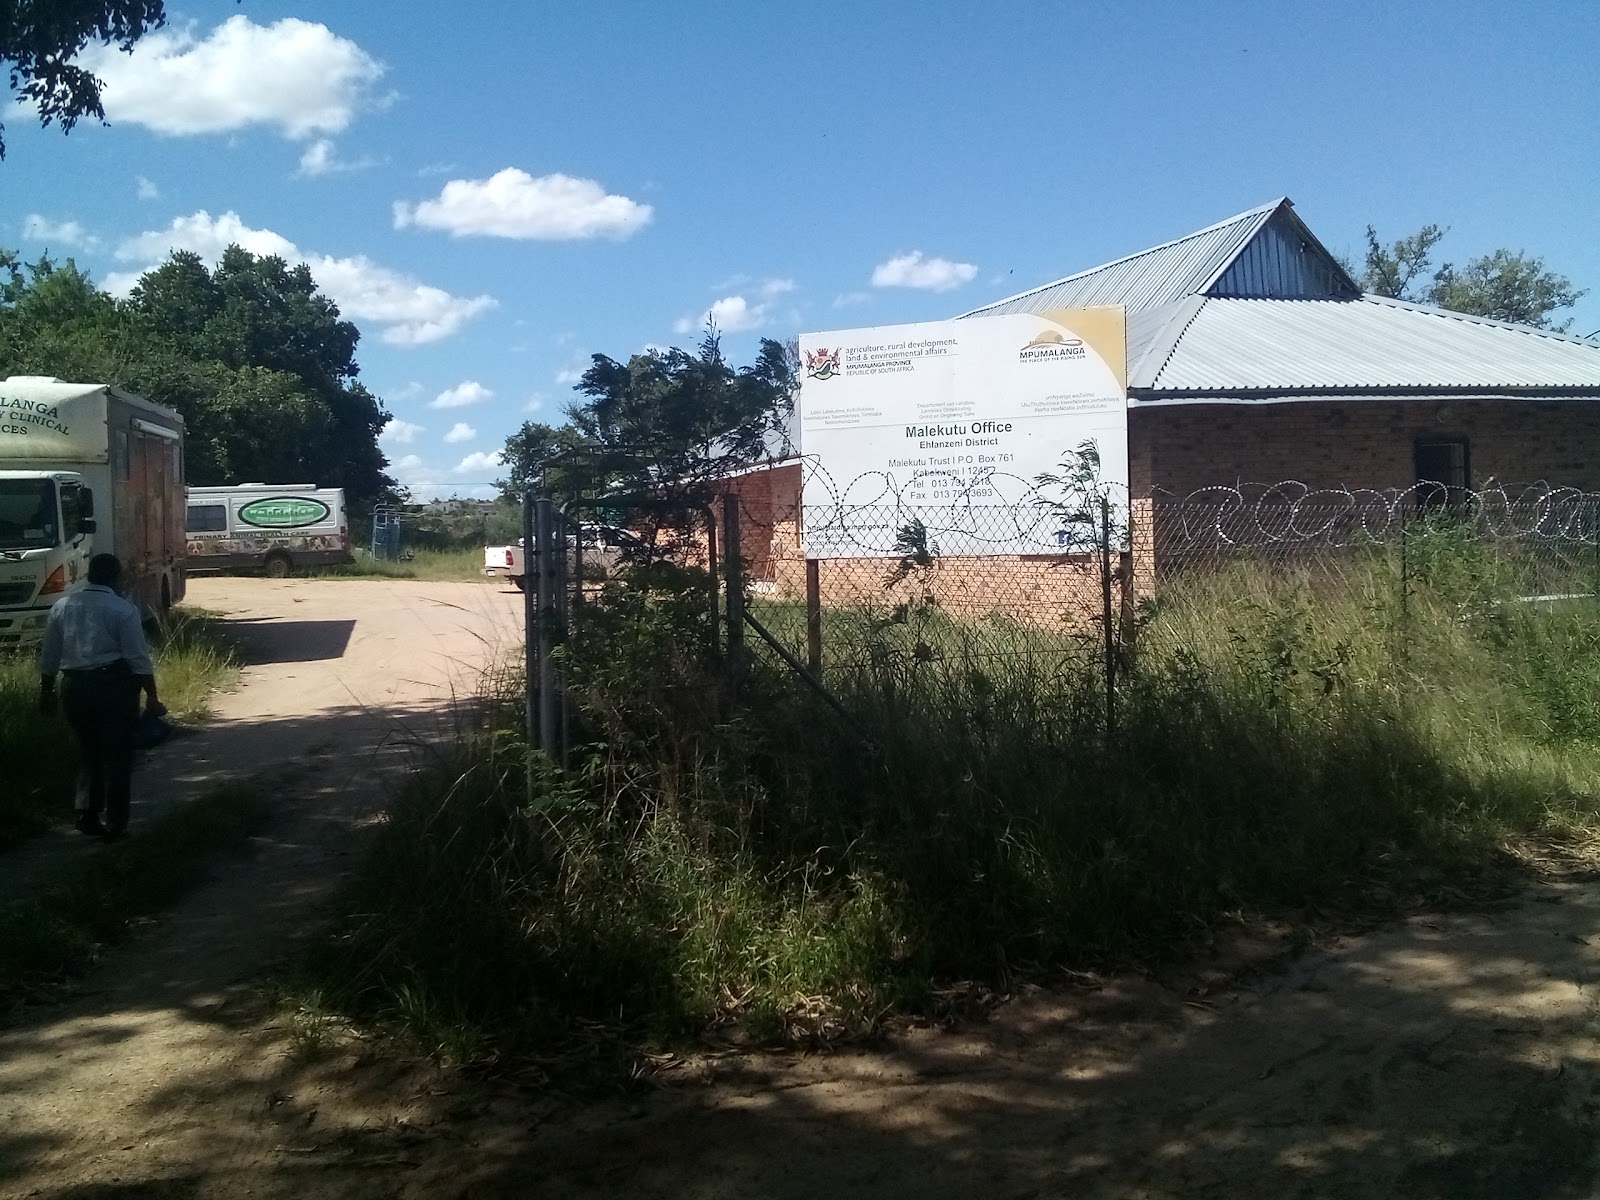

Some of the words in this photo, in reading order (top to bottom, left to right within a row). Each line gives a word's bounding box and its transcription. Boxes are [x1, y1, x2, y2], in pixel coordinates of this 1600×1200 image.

[888, 341, 906, 350] rural
[845, 354, 861, 362] land
[870, 351, 923, 361] environmental
[924, 347, 947, 356] affairs
[1019, 347, 1086, 359] MPUMALANGA
[846, 362, 885, 370] MPUMALANGA
[896, 365, 915, 373] AFRICA
[0, 397, 58, 418] LANGA
[10, 411, 70, 436] CLINICAL
[905, 424, 967, 438] Malekutu
[971, 421, 1013, 434] Office
[919, 438, 963, 449] Ehlanzeni
[965, 437, 999, 447] District
[888, 457, 927, 468] Malekutu
[928, 456, 951, 466] Trust
[978, 454, 996, 463] Box
[998, 453, 1015, 462] 761
[912, 480, 925, 488] Tel
[931, 479, 948, 488] 013
[910, 491, 927, 500] Fax
[933, 490, 950, 499] 013
[971, 488, 993, 498] 3693
